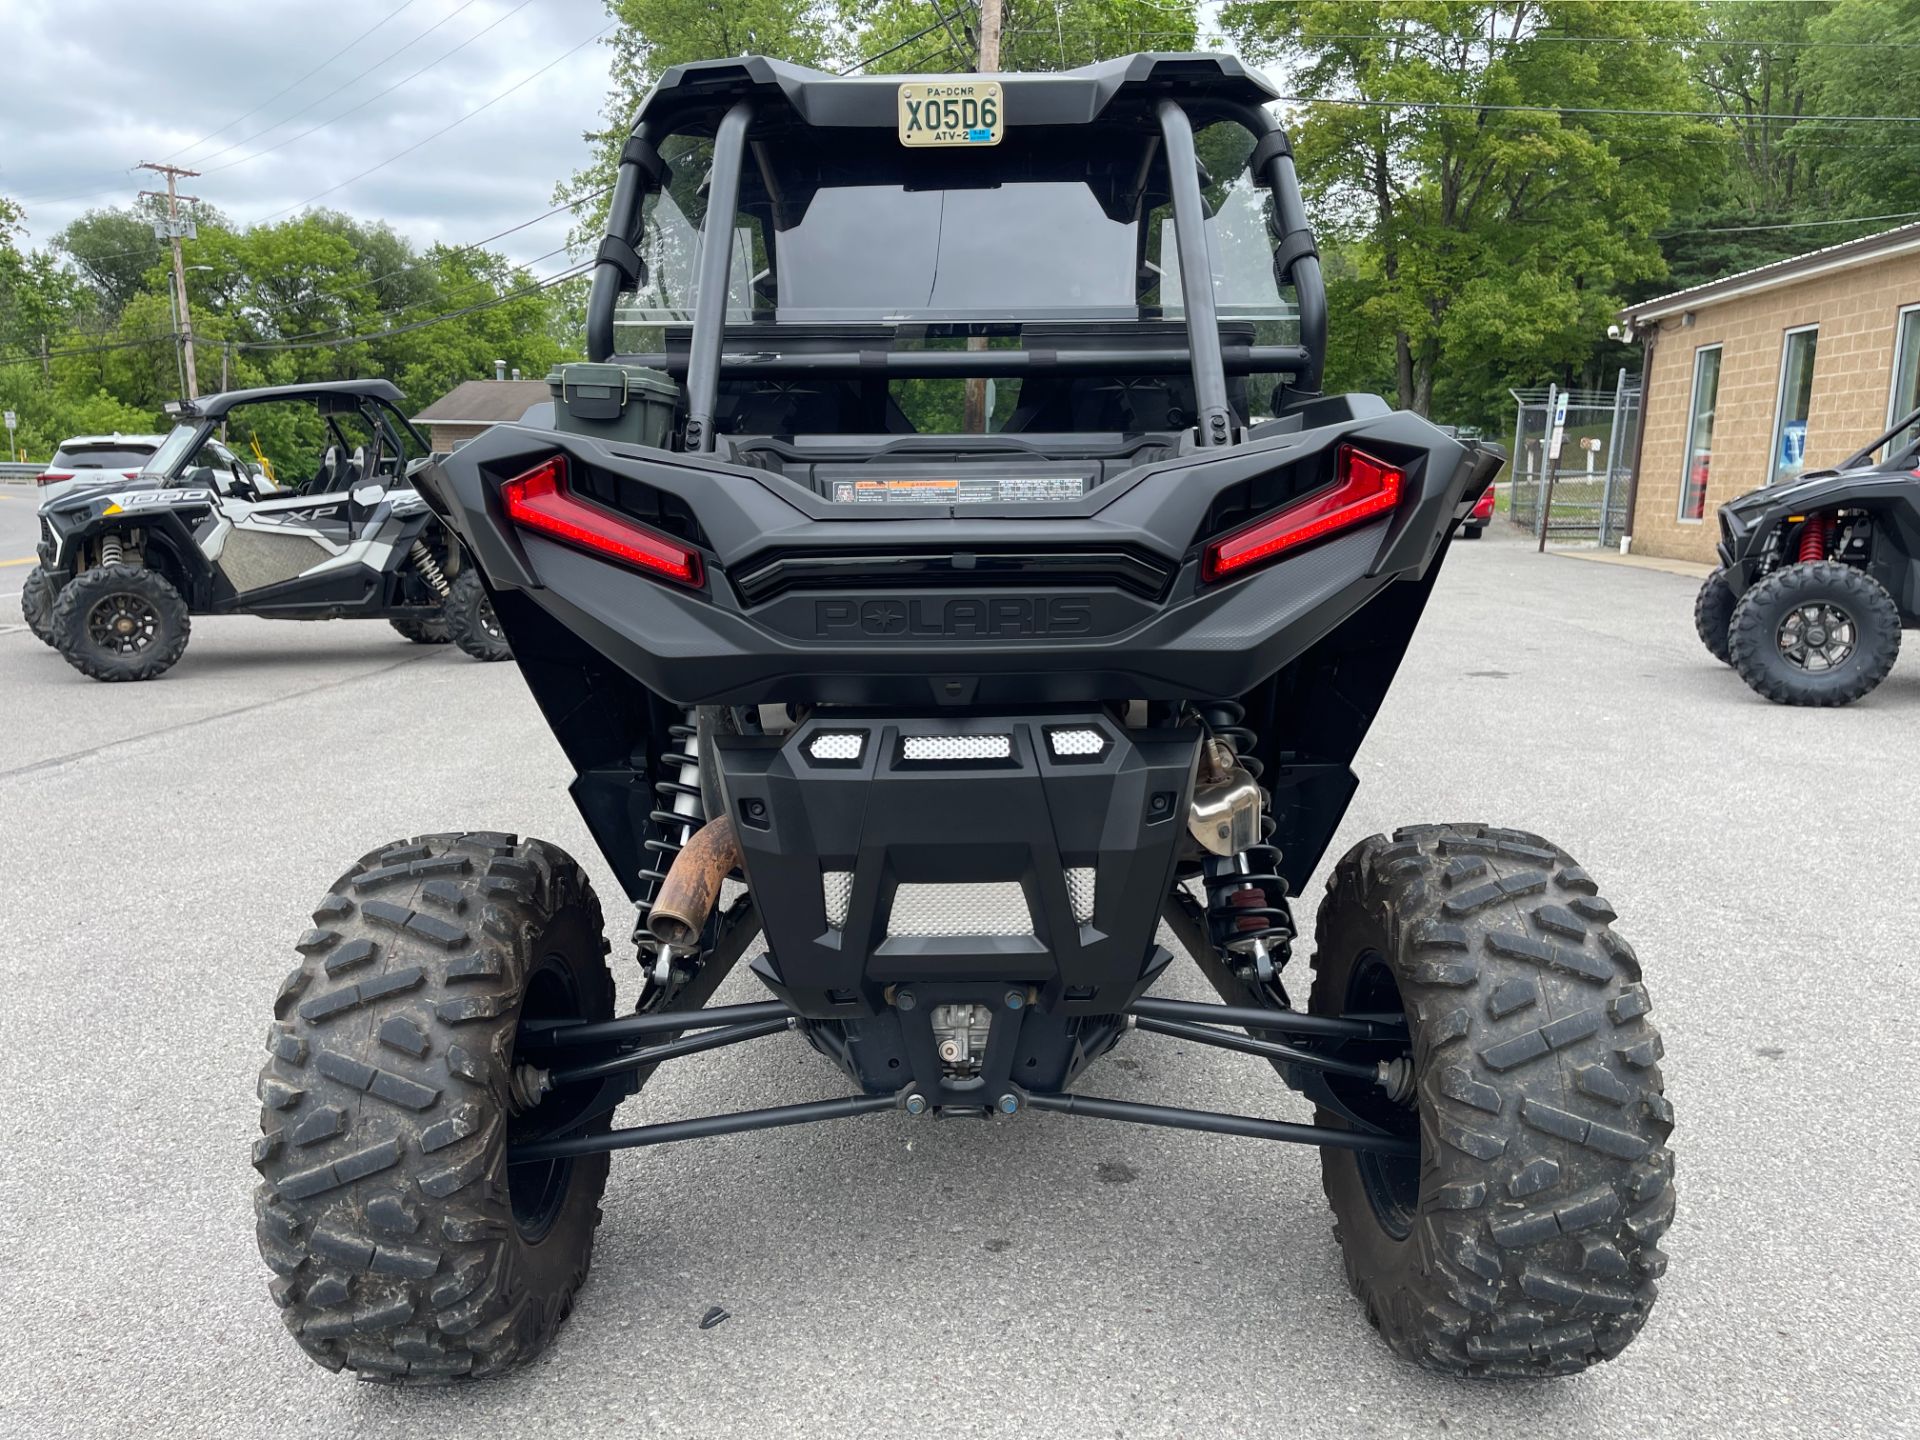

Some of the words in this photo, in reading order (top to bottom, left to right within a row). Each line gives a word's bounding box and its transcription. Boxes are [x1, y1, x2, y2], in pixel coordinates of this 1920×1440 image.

[927, 87, 974, 96] PA-DCNR
[906, 98, 997, 130] X05D6
[123, 491, 208, 505] 1000
[286, 506, 339, 521] XP
[815, 597, 1092, 635] POLARIS
